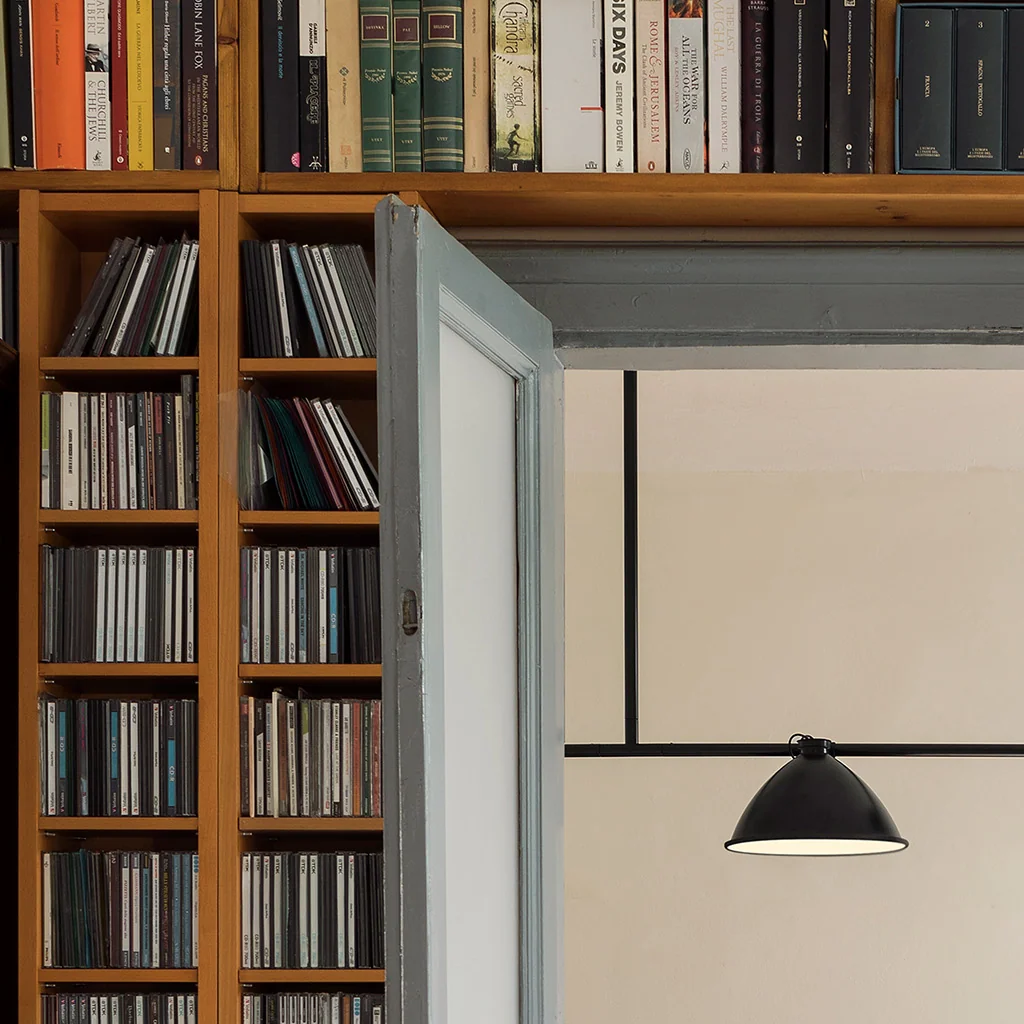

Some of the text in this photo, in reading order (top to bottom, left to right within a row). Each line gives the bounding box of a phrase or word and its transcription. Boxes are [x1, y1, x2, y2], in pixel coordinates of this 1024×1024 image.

[163, 24, 171, 42] Hitler
[499, 2, 529, 54] Chandra
[726, 5, 735, 54] THE LAST
[755, 22, 762, 32] LA
[924, 20, 930, 28] 2
[977, 21, 983, 29] 3
[162, 42, 171, 59] regala
[194, 22, 203, 70] LANE FOX
[681, 35, 690, 56] ALL
[713, 0, 724, 62] MUGHAL
[720, 66, 728, 103] WILLIAM
[612, 0, 626, 152] IX DAYS JEREMY BOWEN
[642, 67, 648, 76] of
[648, 21, 660, 143] ROME JERUSALEM
[691, 65, 699, 91] WAR
[755, 78, 762, 88] DI
[163, 84, 171, 95] agli
[512, 75, 526, 107] sacred
[682, 77, 691, 125] OCEANS
[87, 80, 98, 142] & THE JEWS
[97, 80, 107, 142] CHURCHILL
[504, 93, 516, 119] games
